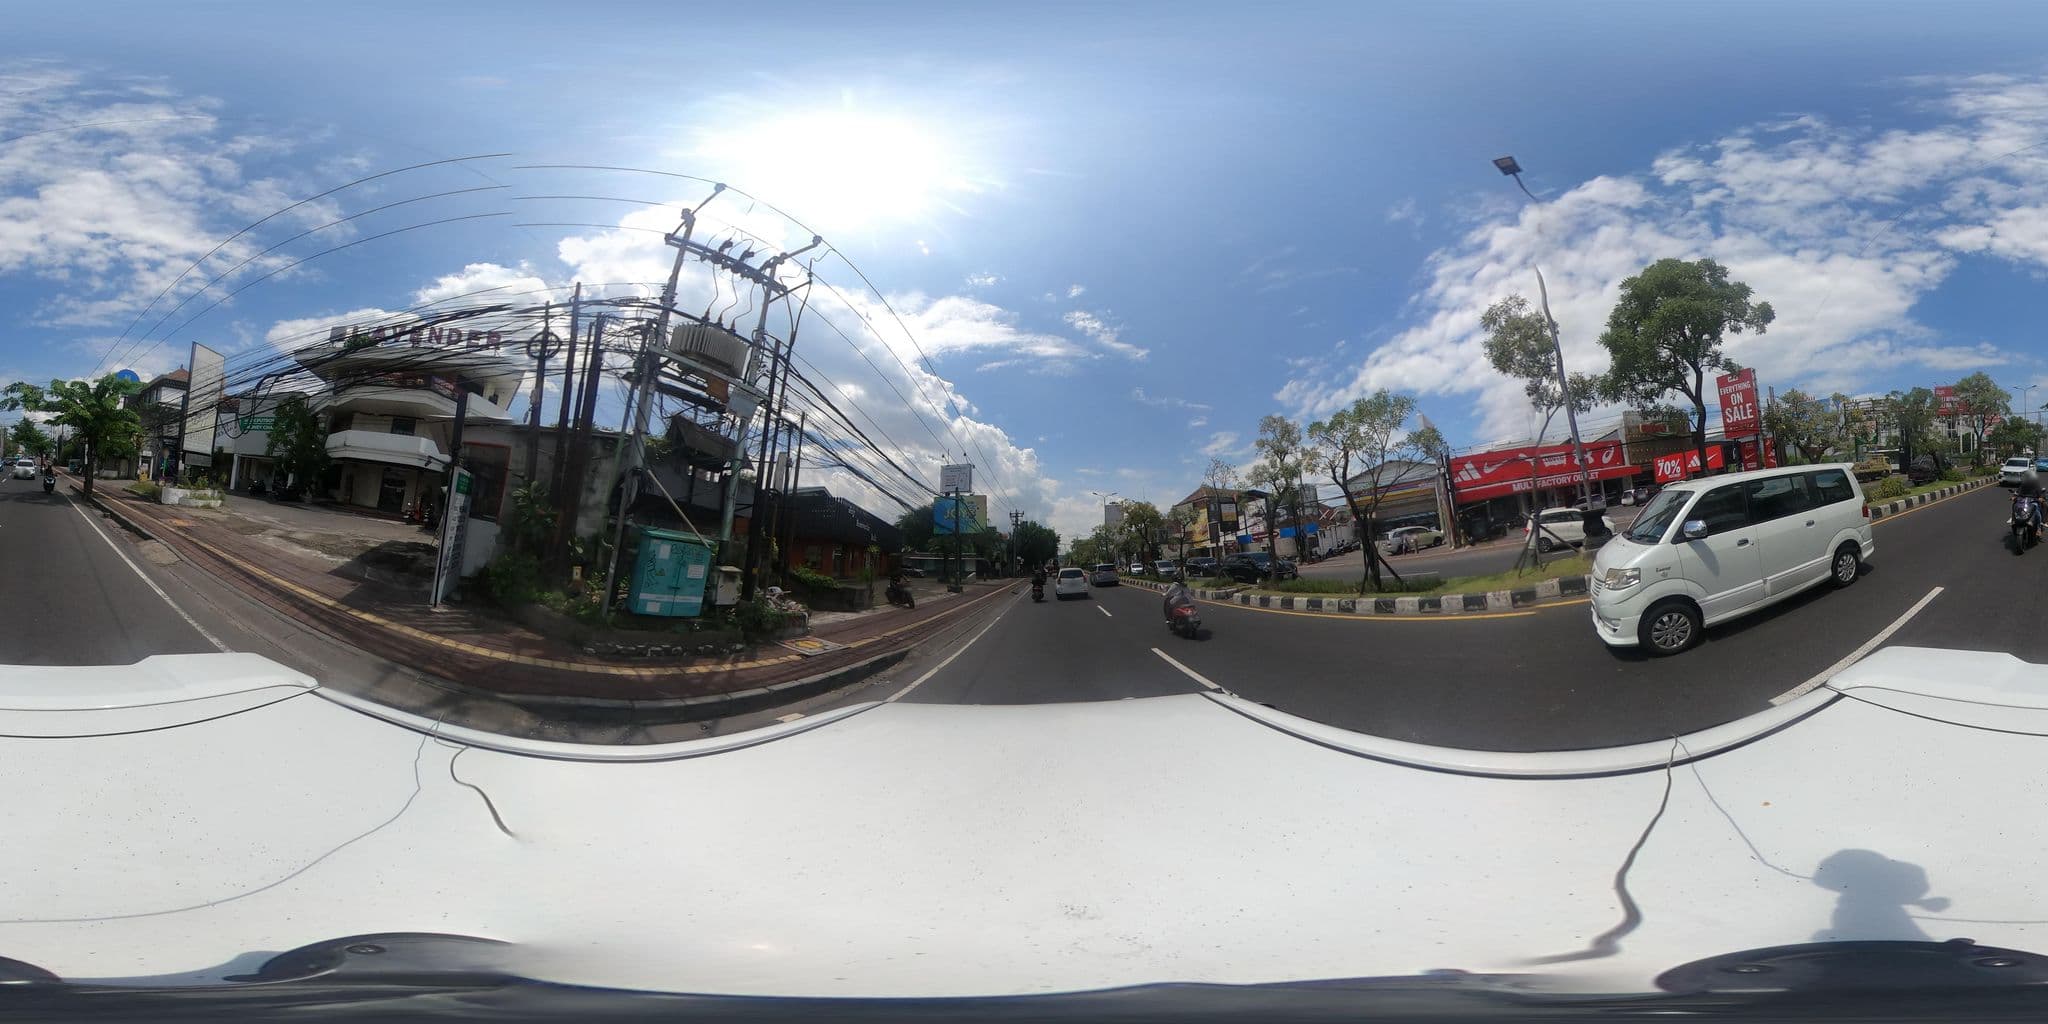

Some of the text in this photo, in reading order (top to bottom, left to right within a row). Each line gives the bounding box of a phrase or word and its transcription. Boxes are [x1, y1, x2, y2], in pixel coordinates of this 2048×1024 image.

[1719, 380, 1752, 396] EVERYTHING
[1730, 391, 1744, 406] ON
[1725, 402, 1754, 424] SALE
[1657, 457, 1681, 477] 70%
[1512, 471, 1599, 492] MULT FACTORY OUET
